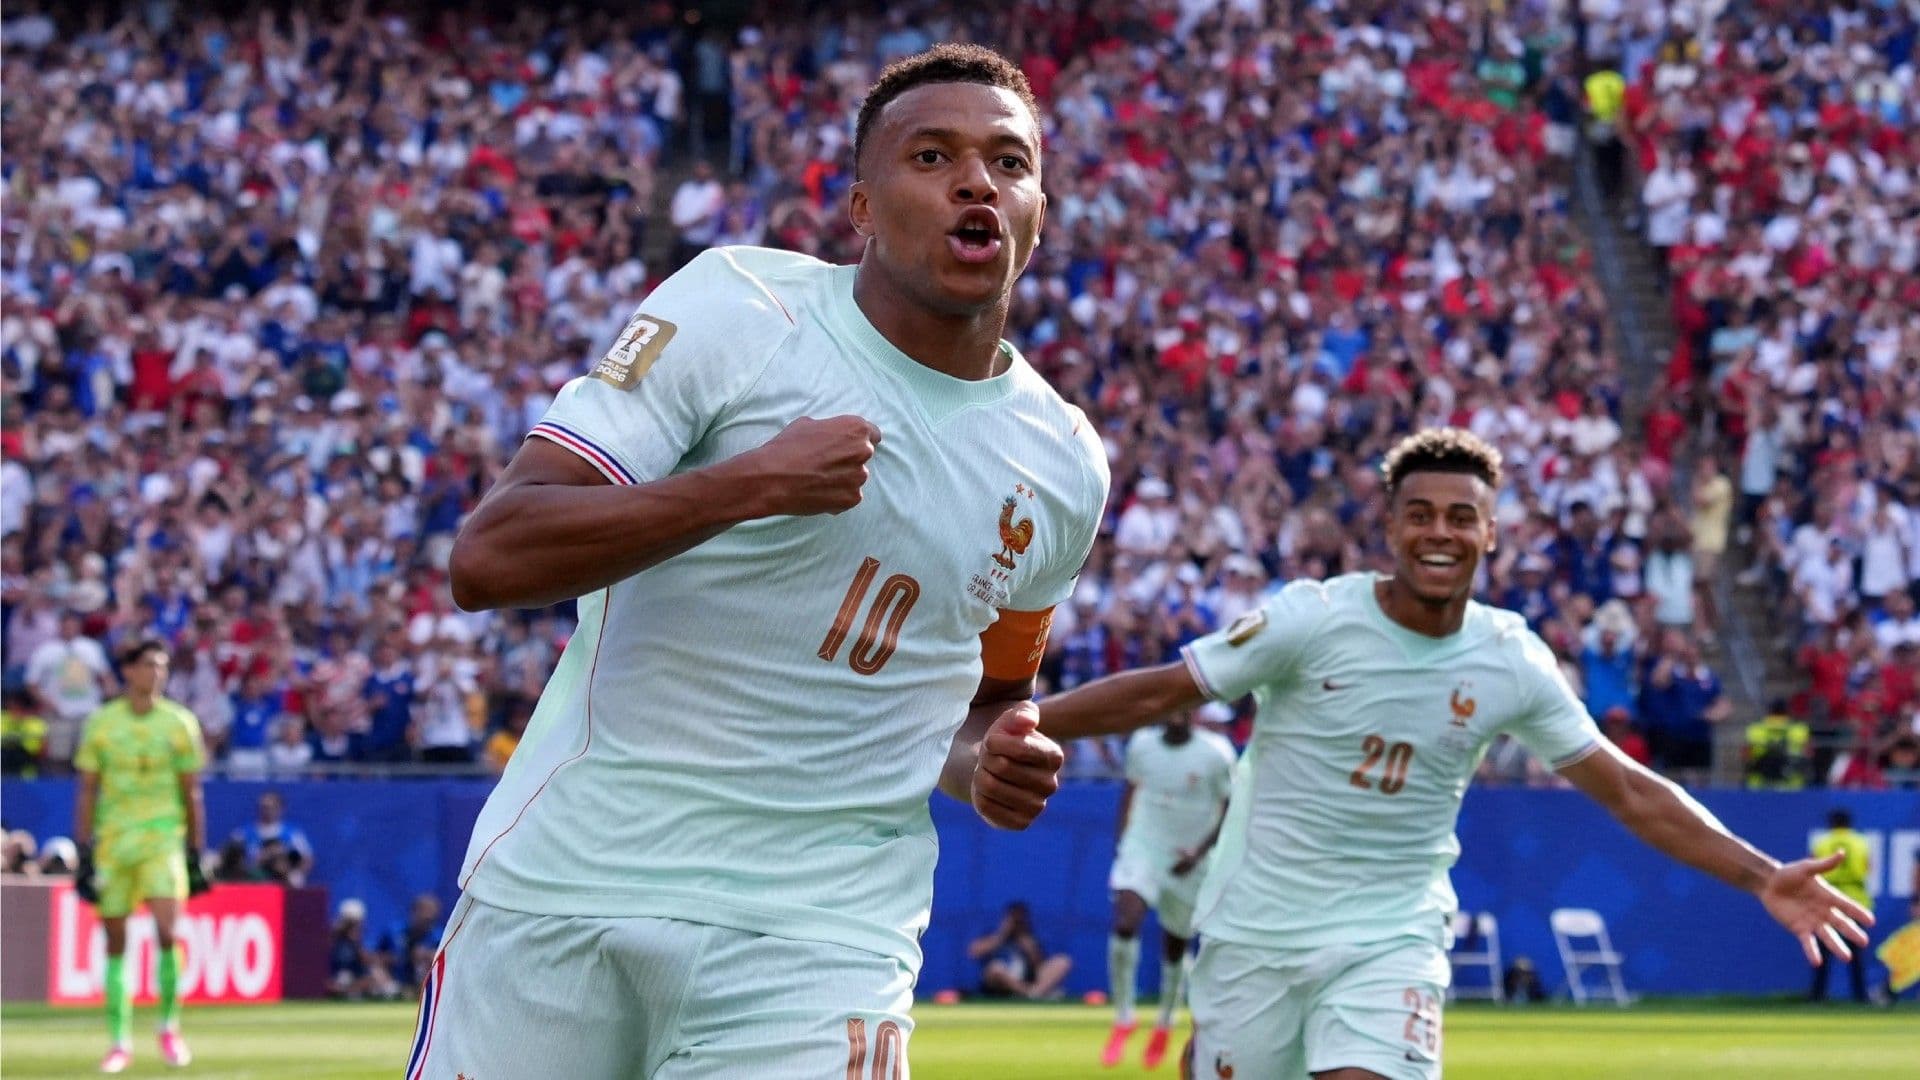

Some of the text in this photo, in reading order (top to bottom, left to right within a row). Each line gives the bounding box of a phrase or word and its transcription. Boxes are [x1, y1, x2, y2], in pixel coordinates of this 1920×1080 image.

[595, 364, 627, 382] 2026
[970, 573, 993, 592] FRANCE
[817, 556, 920, 675] 10
[1349, 734, 1414, 795] 20
